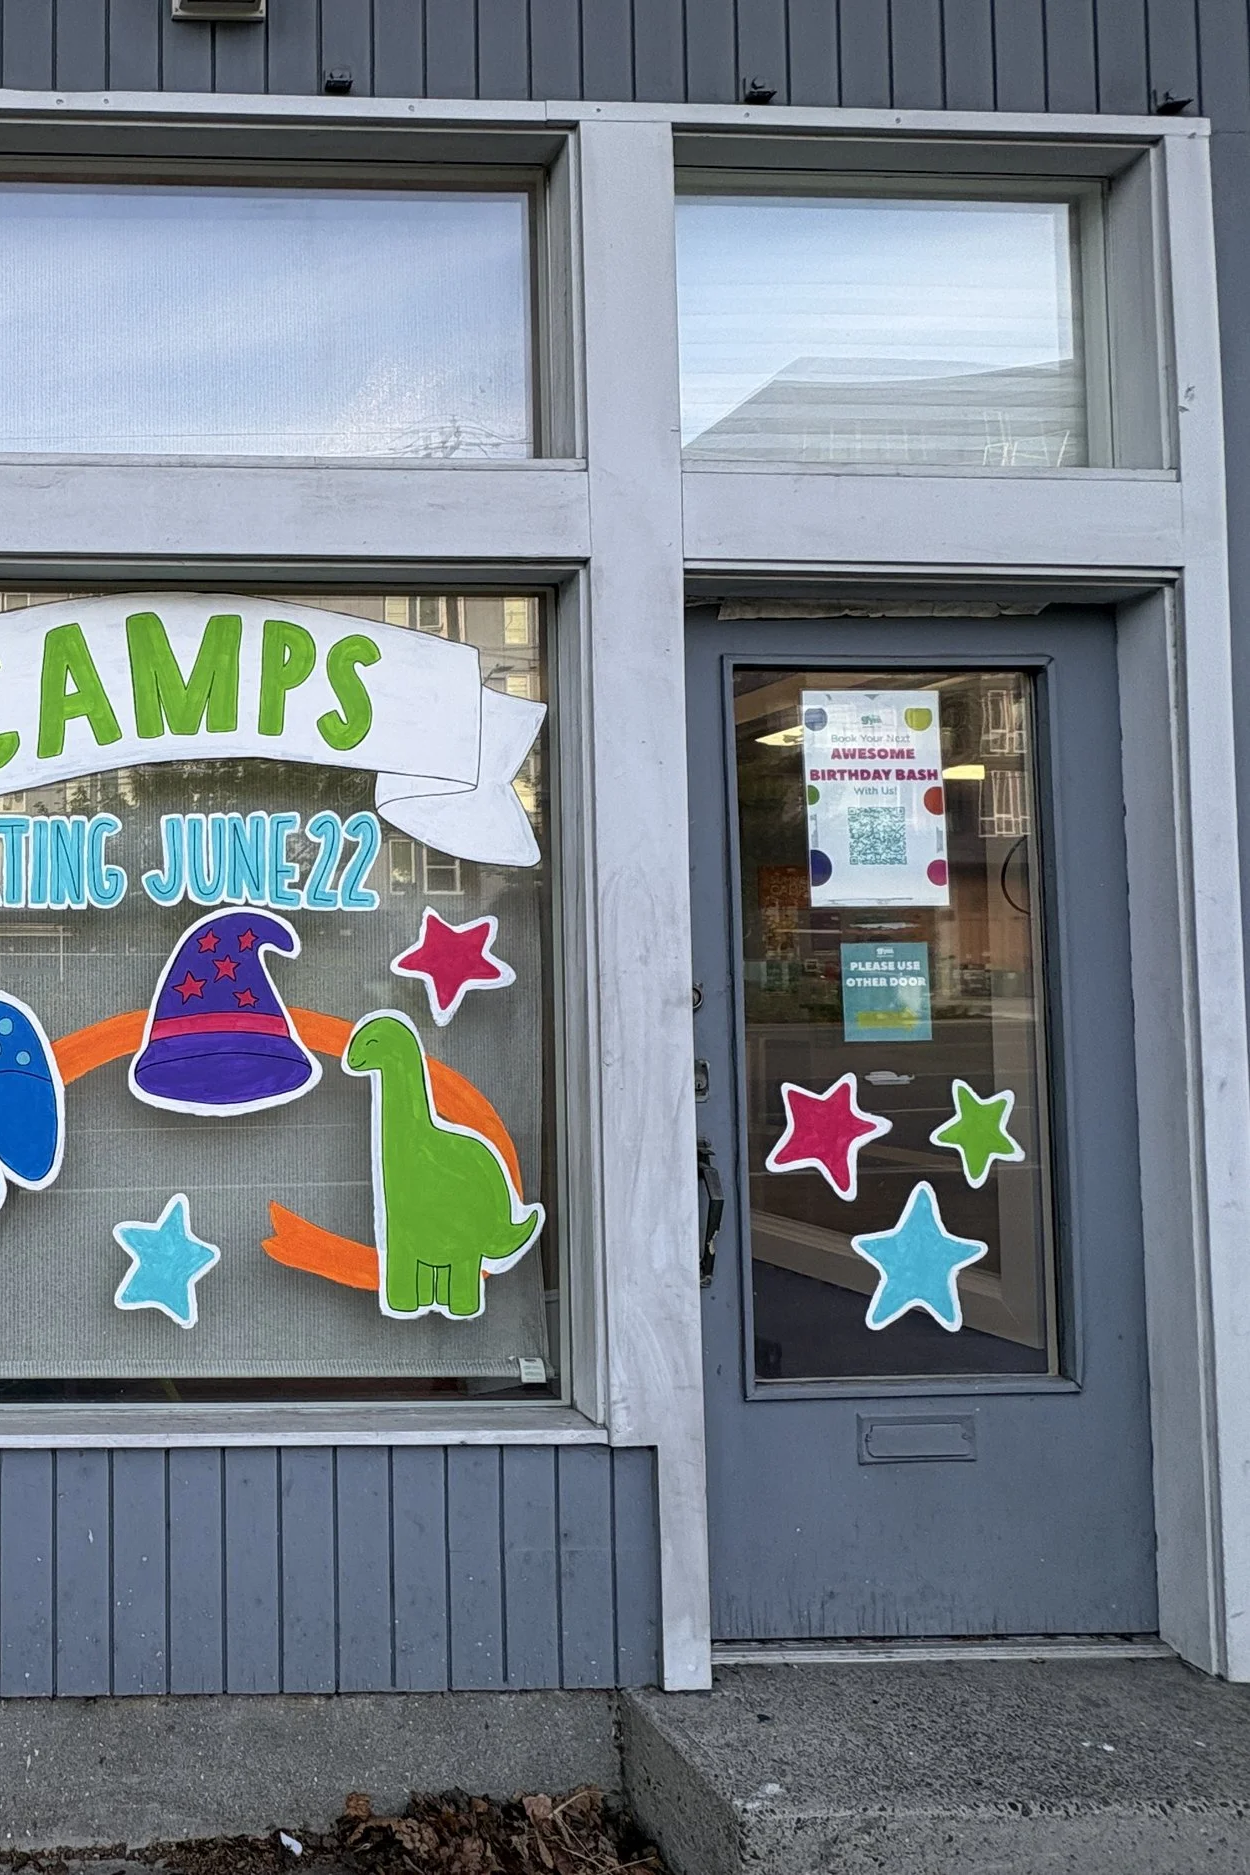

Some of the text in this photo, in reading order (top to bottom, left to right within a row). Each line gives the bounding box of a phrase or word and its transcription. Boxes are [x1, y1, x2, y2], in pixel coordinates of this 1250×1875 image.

[831, 734, 911, 743] Book Your Next
[831, 748, 916, 760] AWESOME
[809, 769, 938, 781] BIRTHDAY BASH
[854, 786, 898, 795] With Us!
[141, 811, 301, 911] JUNE
[302, 810, 382, 911] 22
[850, 961, 921, 971] PLEASE USE
[846, 977, 927, 987] OTHER DOOR
